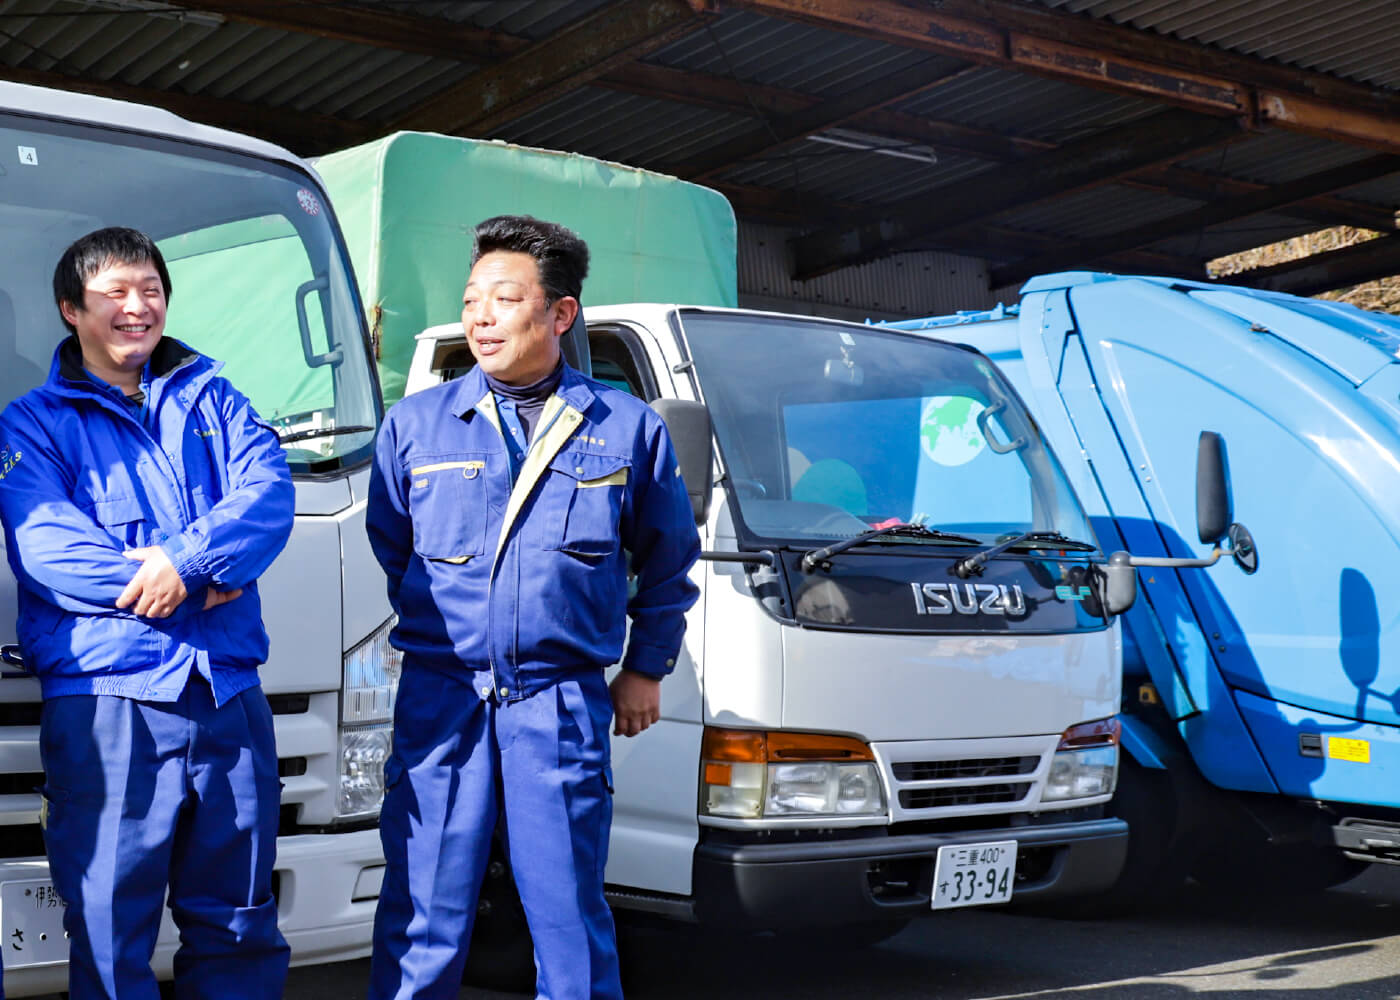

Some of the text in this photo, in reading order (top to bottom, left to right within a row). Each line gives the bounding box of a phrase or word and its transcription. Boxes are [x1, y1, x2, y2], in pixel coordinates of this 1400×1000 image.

[911, 582, 1027, 616] ISUZU
[35, 886, 68, 908] 伊勢
[11, 927, 24, 951] さ
